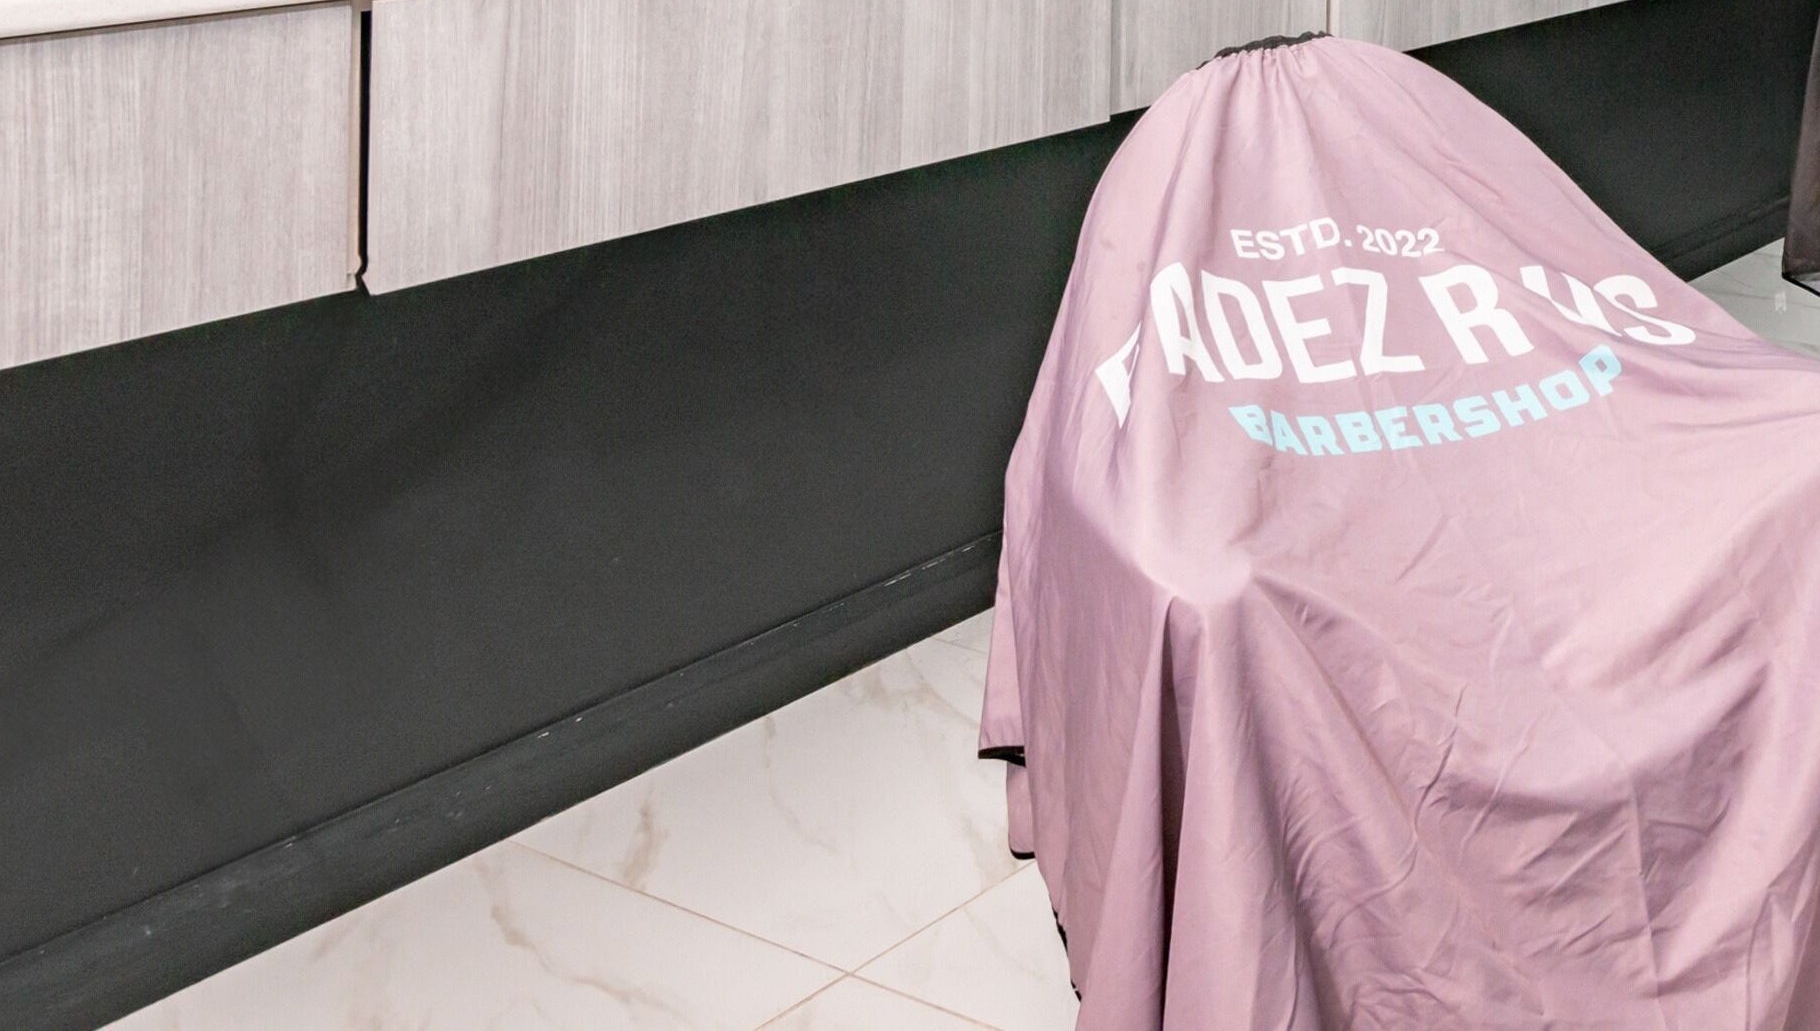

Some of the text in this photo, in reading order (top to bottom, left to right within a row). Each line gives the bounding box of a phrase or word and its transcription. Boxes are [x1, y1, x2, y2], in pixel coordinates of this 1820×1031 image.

[1230, 216, 1444, 261] ESTD. 2022
[1418, 264, 1535, 366] R
[1229, 344, 1623, 458] BARBERSHOP
